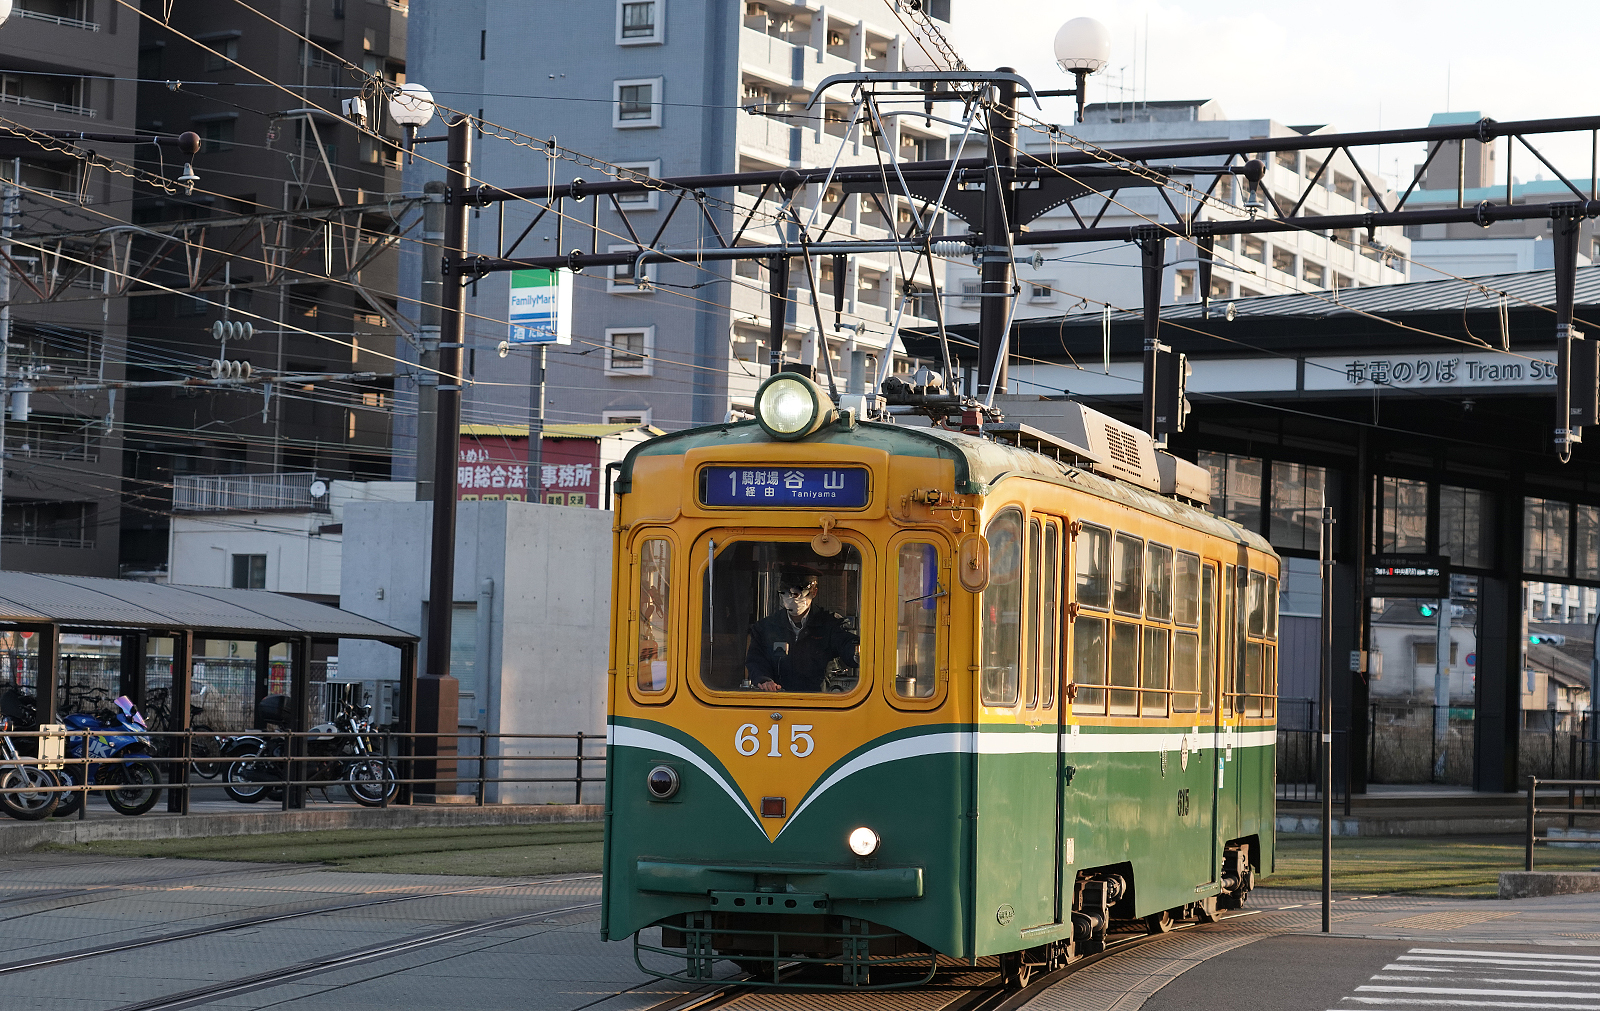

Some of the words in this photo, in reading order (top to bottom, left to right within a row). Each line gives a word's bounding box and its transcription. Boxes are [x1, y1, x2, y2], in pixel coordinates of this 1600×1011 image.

[511, 294, 556, 307] FamilyMart
[513, 325, 526, 340] 酒
[529, 325, 553, 338] たばこ
[1345, 358, 1458, 384] 市電のりば
[1465, 360, 1523, 381] Tram
[458, 463, 592, 488] 明総合法事務所
[729, 471, 737, 497] 1
[742, 471, 778, 485] 騎射場
[746, 486, 775, 497] 経由
[792, 490, 836, 498] Taniyama
[735, 723, 815, 758] 615
[1178, 788, 1189, 816] 615
